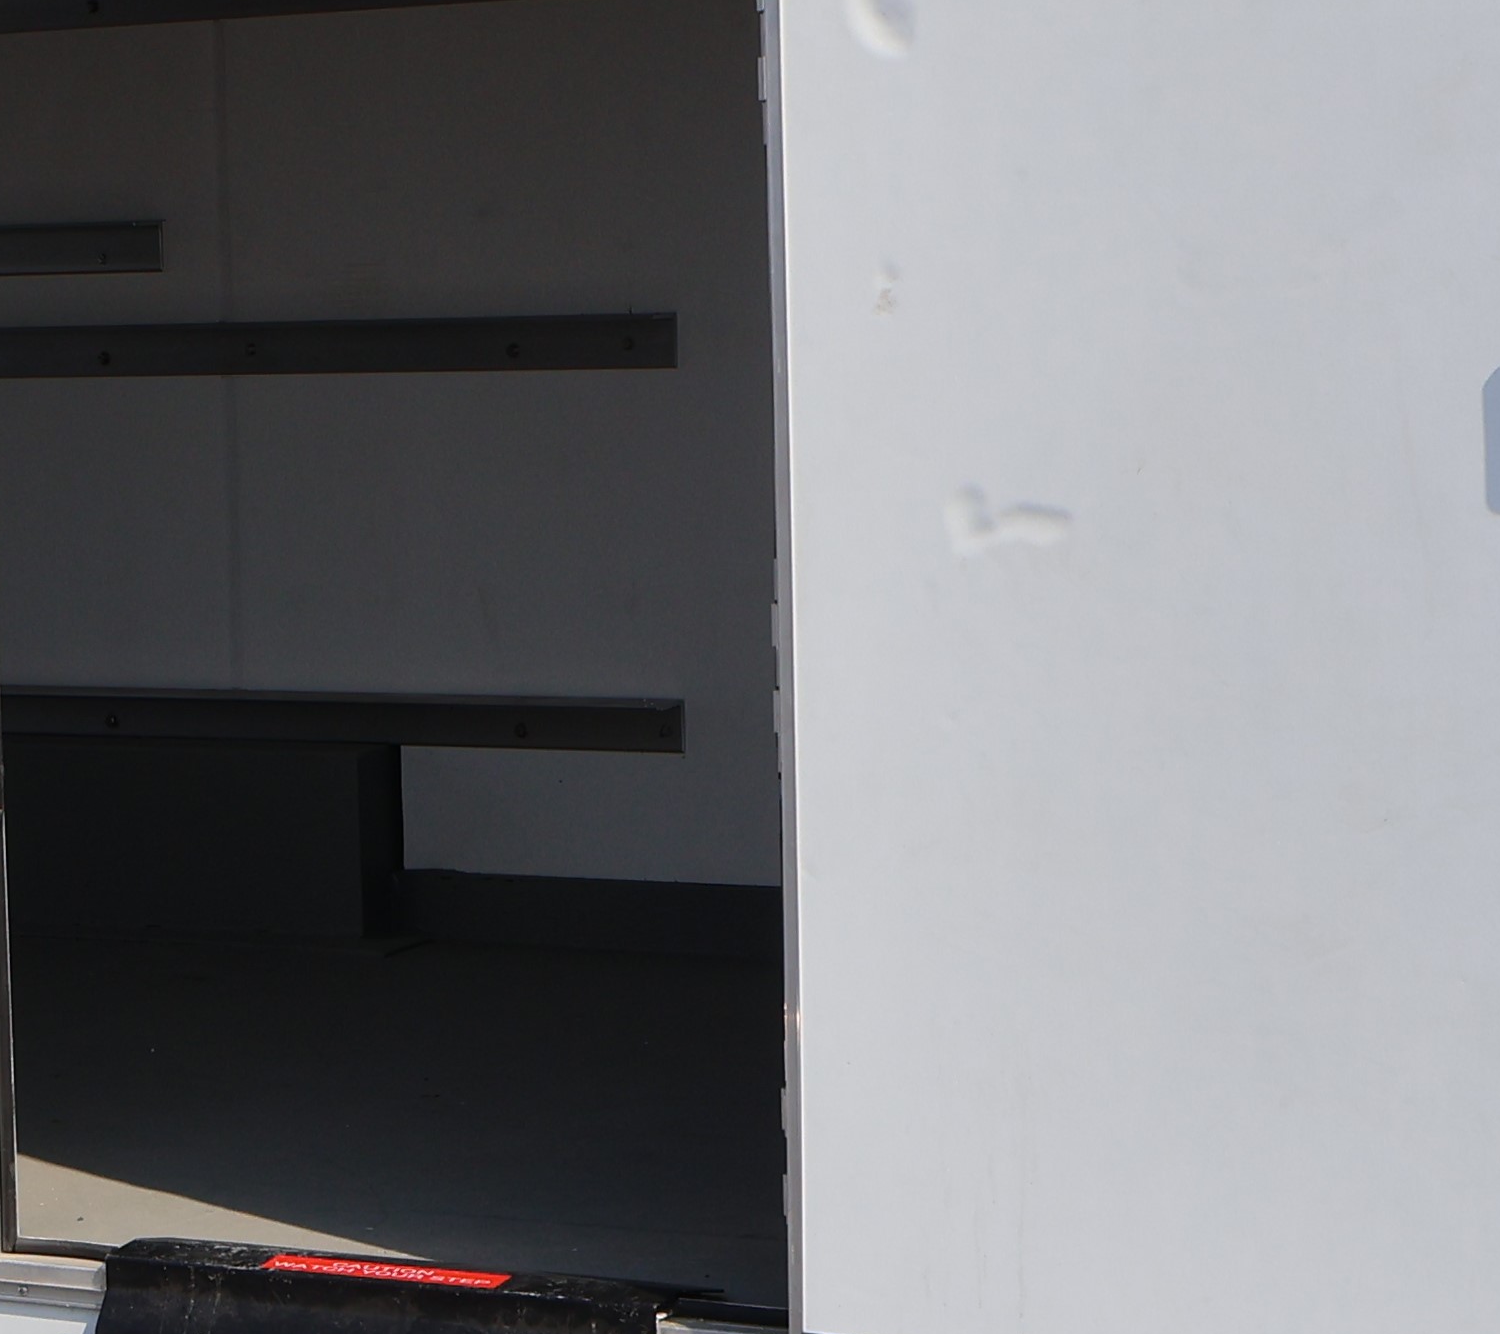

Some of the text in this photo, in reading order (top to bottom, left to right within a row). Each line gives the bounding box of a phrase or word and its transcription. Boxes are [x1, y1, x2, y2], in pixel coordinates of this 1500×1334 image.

[273, 1261, 492, 1285] WATCH YOUR STEP
[332, 1262, 435, 1276] CAUTION
